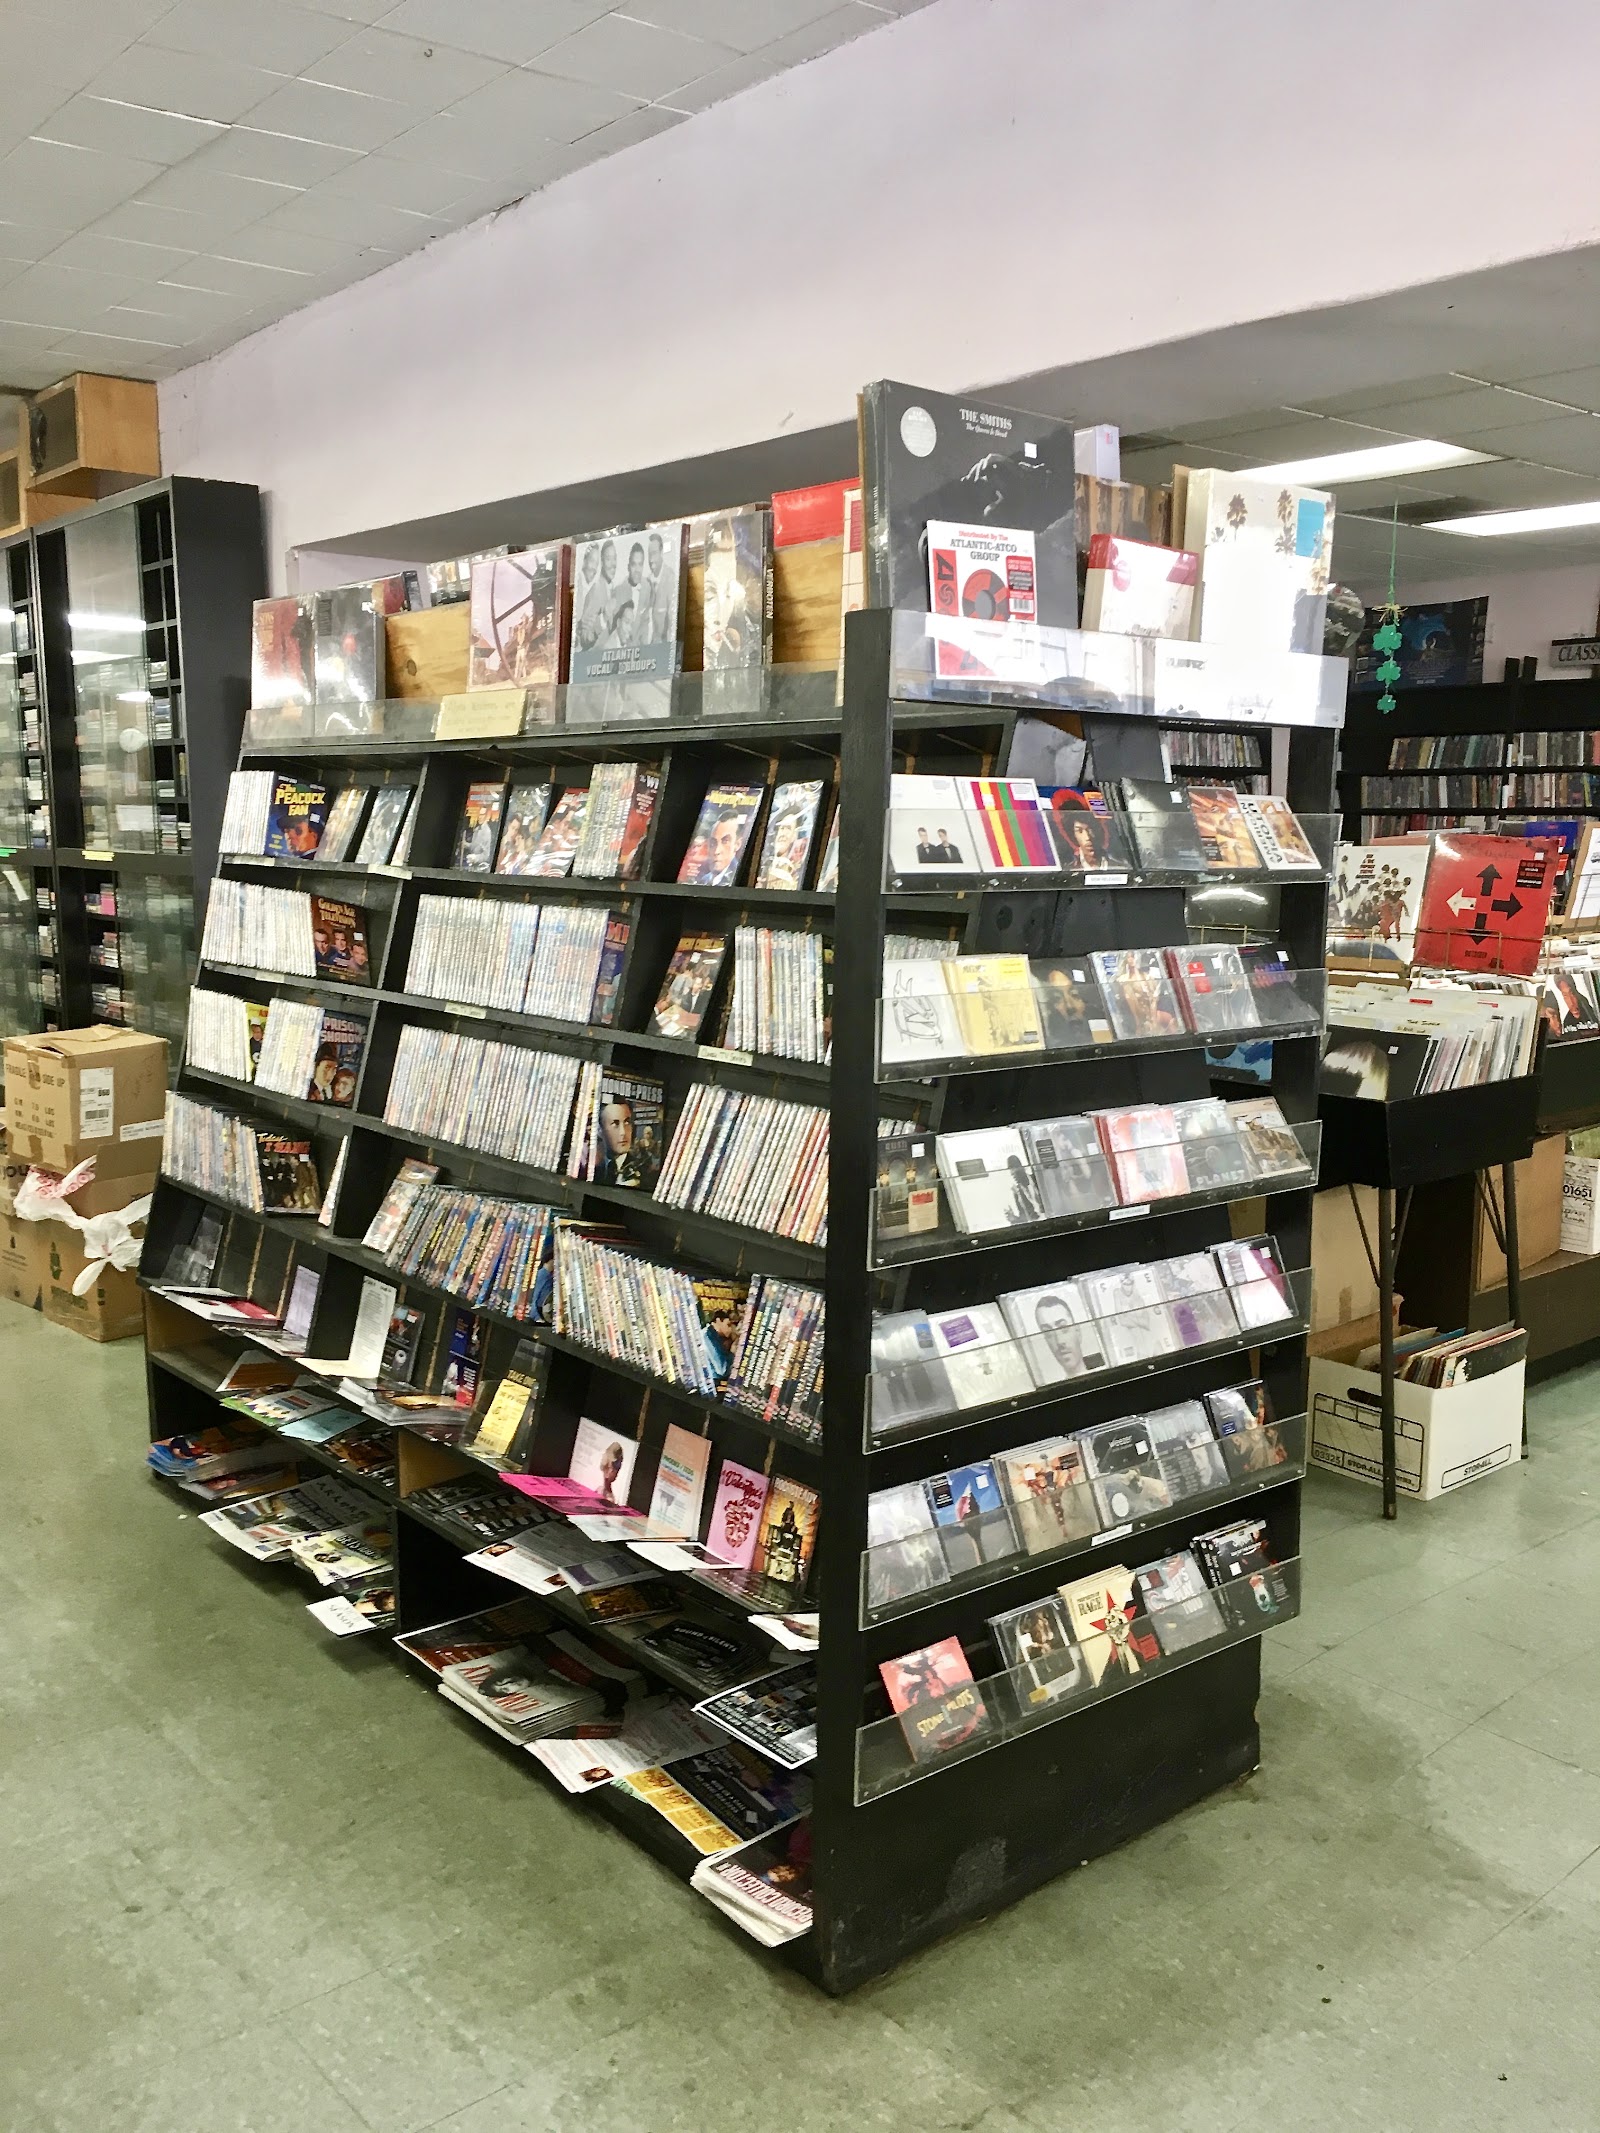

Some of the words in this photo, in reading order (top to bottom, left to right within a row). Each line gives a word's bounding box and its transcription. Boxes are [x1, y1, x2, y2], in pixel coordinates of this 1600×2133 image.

[959, 408, 979, 422] THE
[979, 413, 1013, 430] SMITHS
[950, 539, 1017, 553] ATLANTIC-ATCO
[970, 551, 1000, 561] GROUP
[602, 647, 640, 664] ATLANTIC
[1558, 645, 1600, 661] CLASS
[587, 663, 612, 677] VOCAL
[275, 788, 326, 805] PEACOCK
[280, 783, 297, 793] The
[288, 804, 309, 816] FAN
[1248, 802, 1283, 863] UTOPIA
[636, 1084, 663, 1104] PRESS
[1196, 1170, 1246, 1187] PLANET
[1562, 1185, 1593, 1198] 01651
[507, 1369, 525, 1383] TAKE
[1315, 1449, 1341, 1464] 03325
[1347, 1459, 1383, 1476] STOR-ALL
[1078, 1597, 1104, 1616] RAGE
[946, 1688, 975, 1711] PILOTS
[916, 1712, 945, 1737] STONE
[719, 1864, 782, 1904] COLLECTOR
[768, 1895, 814, 1923] RECORD
